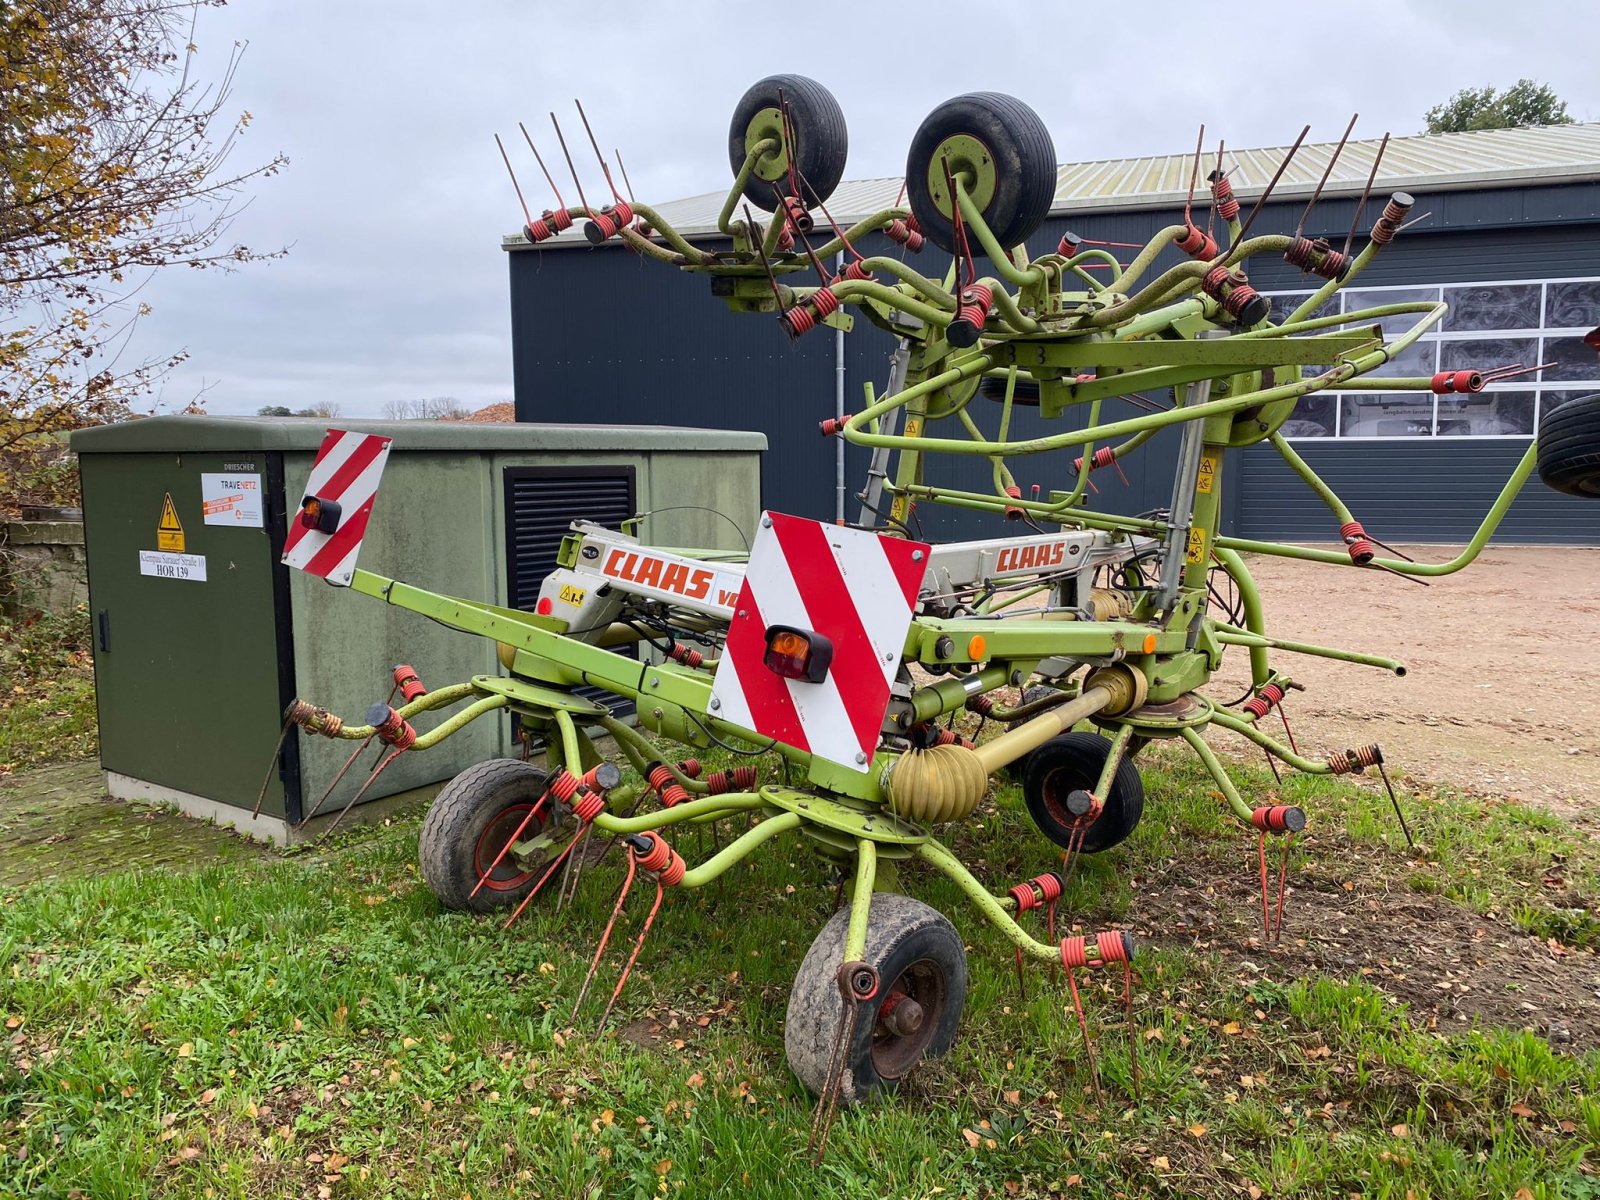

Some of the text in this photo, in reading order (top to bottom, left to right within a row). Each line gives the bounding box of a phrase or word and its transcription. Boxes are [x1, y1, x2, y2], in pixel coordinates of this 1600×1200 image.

[224, 463, 255, 471] DRIESCHER
[996, 542, 1066, 573] CLAAS
[156, 564, 189, 578] HOR 139
[603, 549, 714, 600] CLAAS
